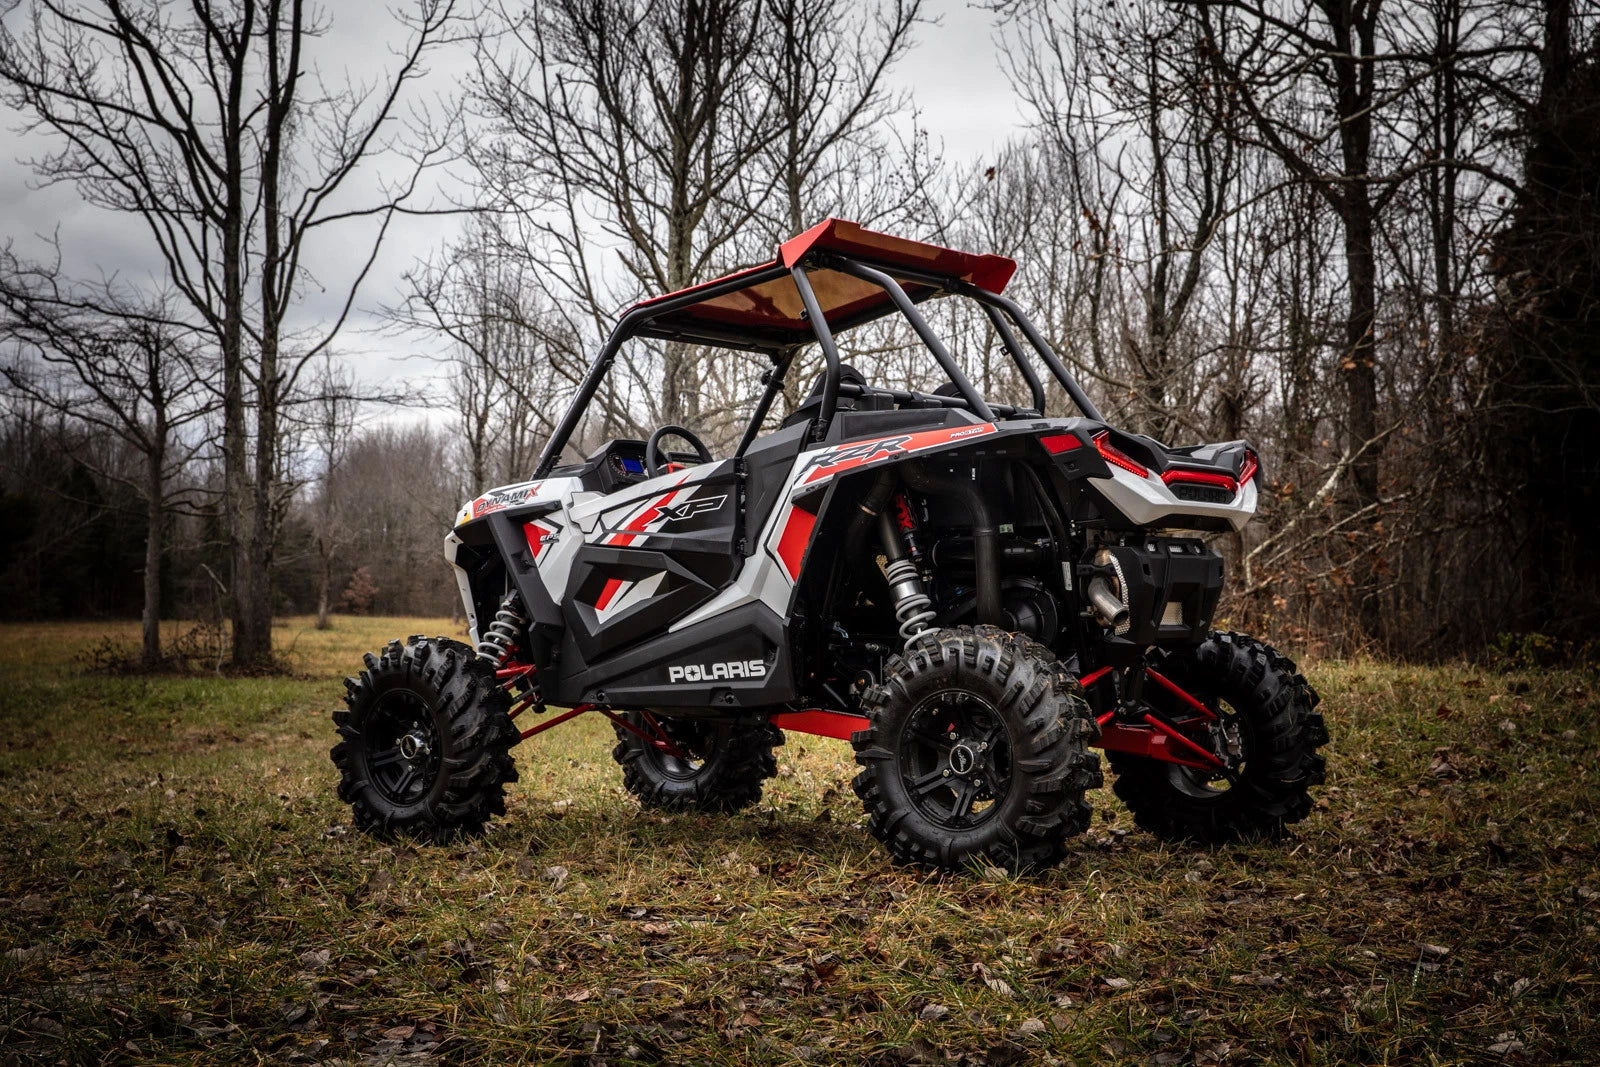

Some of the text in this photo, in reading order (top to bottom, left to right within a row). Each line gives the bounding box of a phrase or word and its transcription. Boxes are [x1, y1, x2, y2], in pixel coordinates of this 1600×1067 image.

[798, 435, 912, 477] RZR
[477, 484, 542, 512] DYNAMIX
[647, 494, 728, 524] XP
[668, 659, 766, 683] POLARIS
